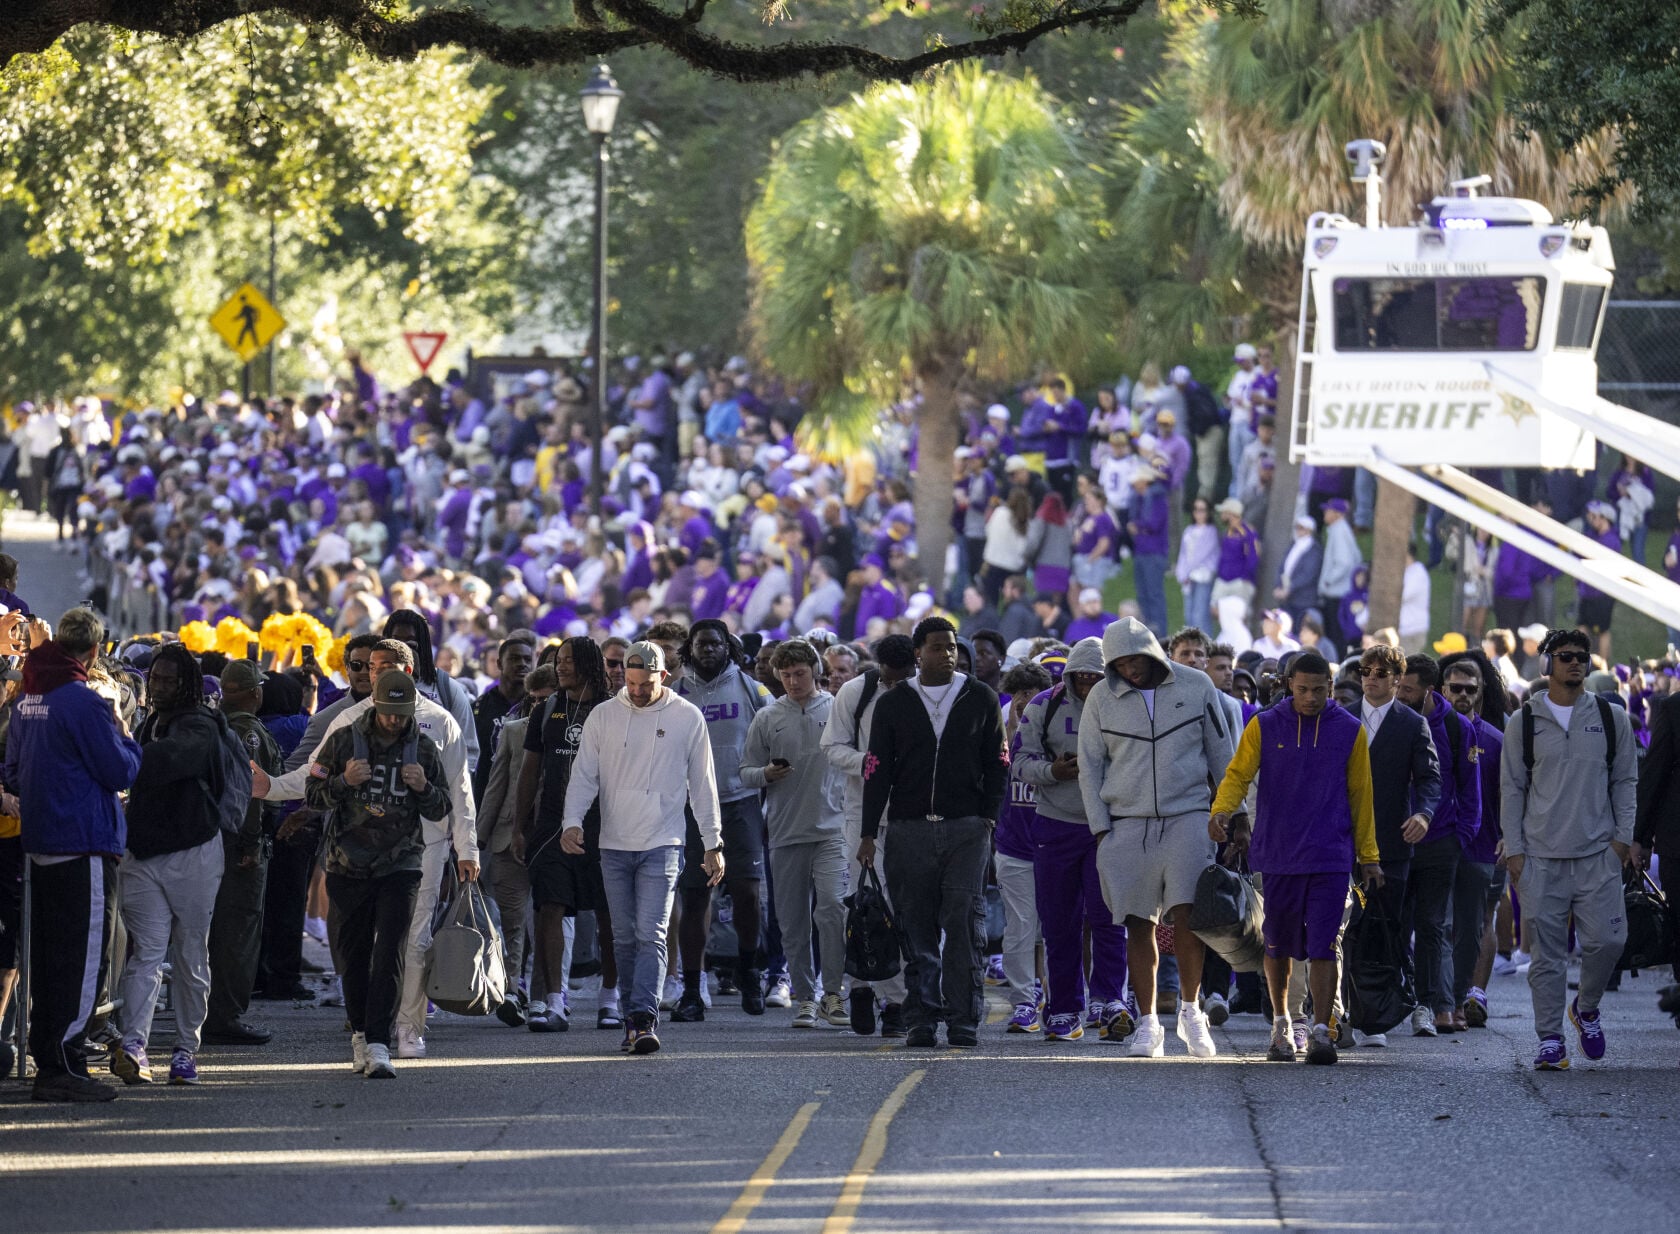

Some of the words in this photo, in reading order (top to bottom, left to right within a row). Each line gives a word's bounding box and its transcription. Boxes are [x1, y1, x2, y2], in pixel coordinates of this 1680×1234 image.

[1454, 261, 1489, 272] TRUST
[1320, 379, 1362, 391] EAST
[1369, 379, 1428, 391] BATON
[1435, 379, 1493, 391] ROUGE
[1319, 401, 1492, 429] SHERIFF
[21, 704, 49, 715] UNIVERSAL
[702, 702, 739, 721] SU
[1584, 725, 1603, 733] LSU
[1010, 781, 1037, 803] TIG
